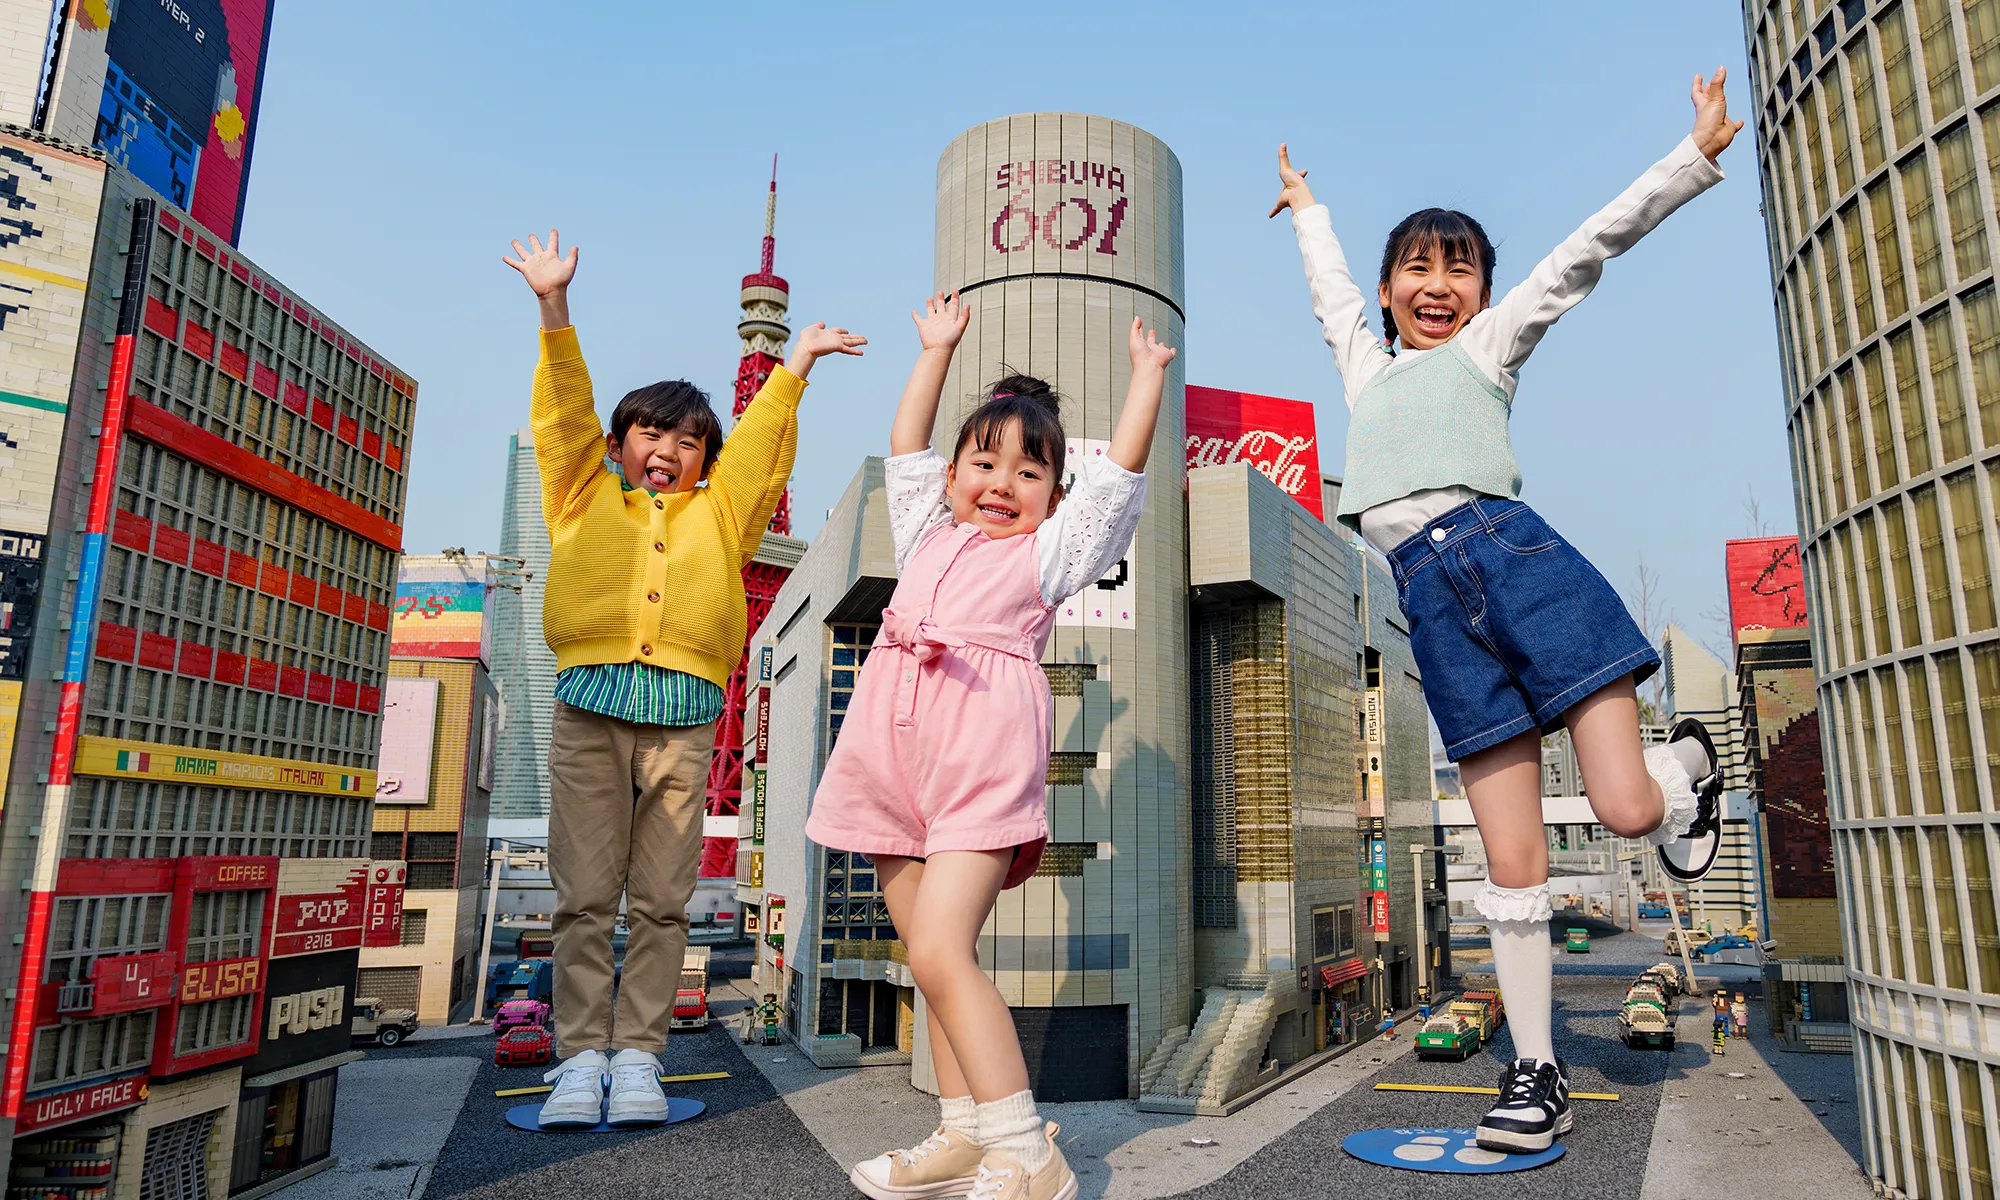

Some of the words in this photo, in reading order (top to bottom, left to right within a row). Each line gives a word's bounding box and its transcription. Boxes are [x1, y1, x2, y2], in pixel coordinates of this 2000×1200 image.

[194, 27, 206, 44] 2
[996, 159, 1126, 193] SHIBUYA
[992, 188, 1129, 257] 601
[1367, 697, 1378, 742] FASHION
[174, 756, 218, 776] MAMA
[221, 761, 275, 781] MARIO'S
[279, 767, 325, 786] ITALIAN
[757, 773, 766, 805] HOUSE
[755, 806, 765, 840] COFFEE
[218, 865, 266, 882] COFFEE
[297, 899, 349, 927] POP
[1376, 898, 1386, 926] CAFE
[304, 933, 333, 950] 221B
[182, 960, 260, 1001] ELISA
[267, 985, 346, 1041] PUSH
[36, 1093, 85, 1123] UGLY
[90, 1081, 133, 1109] FACE
